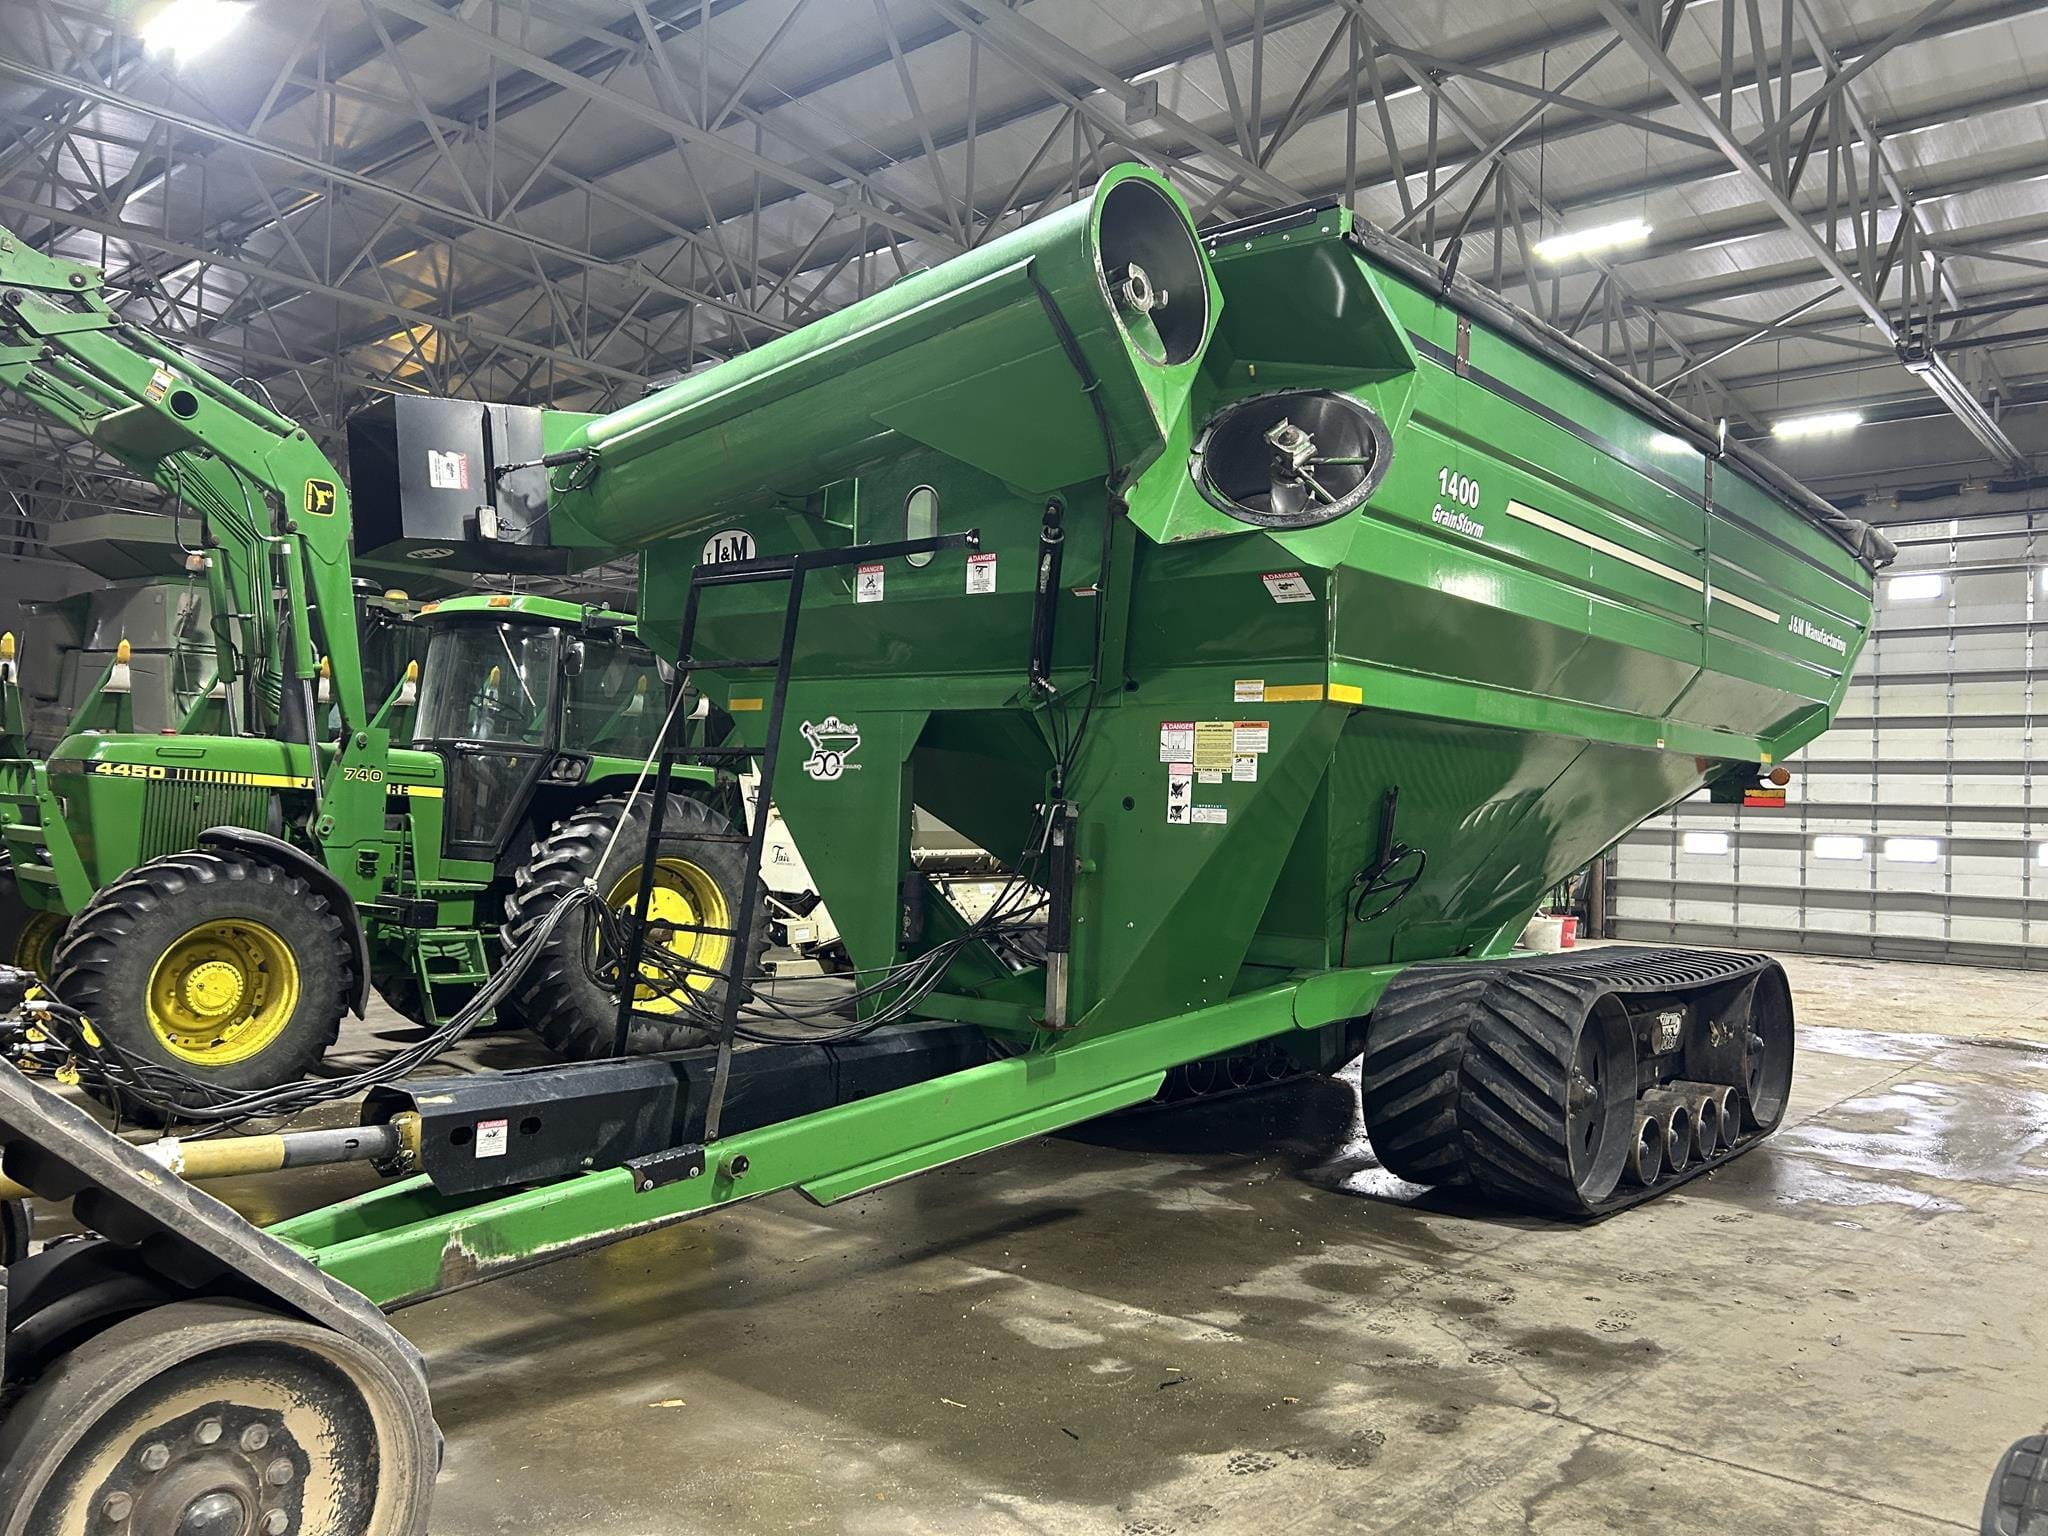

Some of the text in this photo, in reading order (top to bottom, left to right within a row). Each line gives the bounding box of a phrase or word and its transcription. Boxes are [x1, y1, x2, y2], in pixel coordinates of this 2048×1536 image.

[1439, 467, 1480, 510] 1400
[1431, 503, 1484, 538] GrainStorm
[707, 535, 748, 564] J&M
[973, 553, 996, 562] DANGER
[861, 565, 884, 573] DANGER
[1269, 571, 1301, 580] DANGER
[1788, 615, 1846, 656] J&M Manufacturing
[95, 762, 166, 779] 4450
[344, 768, 383, 782] 740
